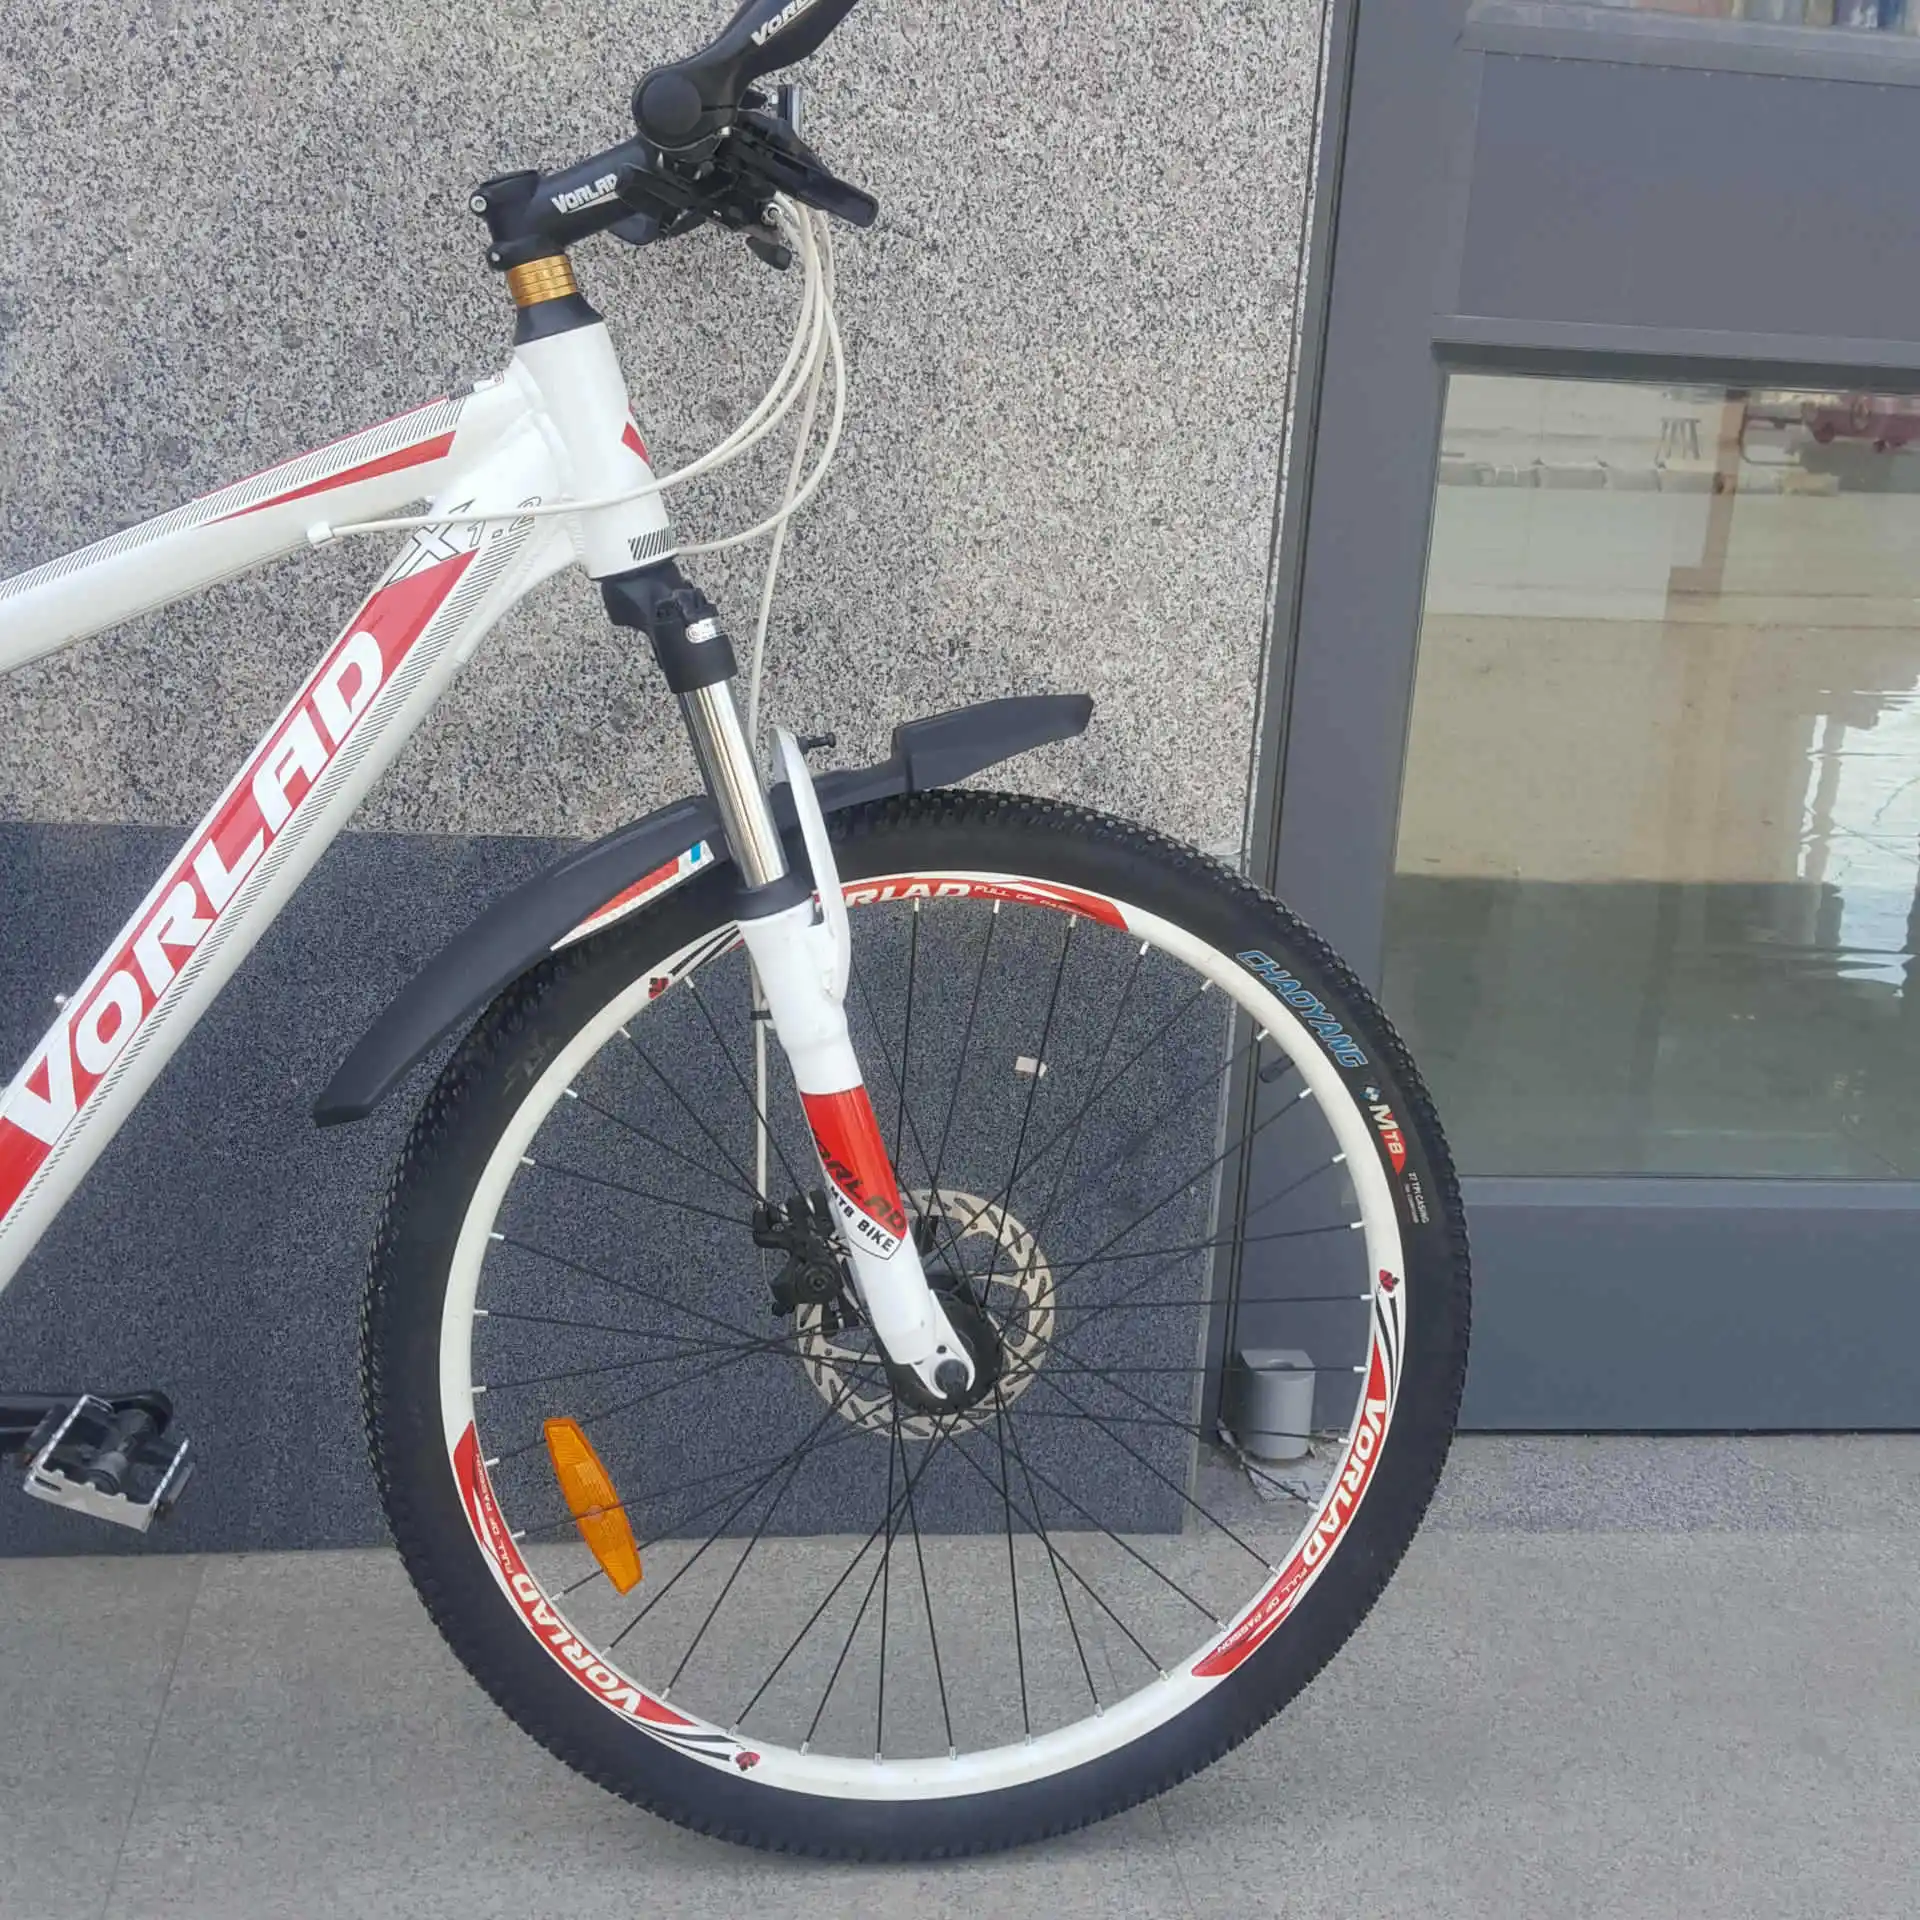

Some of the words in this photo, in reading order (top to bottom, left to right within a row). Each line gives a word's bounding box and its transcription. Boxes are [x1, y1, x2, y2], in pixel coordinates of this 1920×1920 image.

[2, 631, 385, 1146] VORLAD
[1236, 949, 1368, 1068] CHAOYANG
[1368, 1104, 1404, 1155] MTB
[856, 1218, 895, 1252] BIKE
[1302, 1399, 1387, 1567] VORLAD
[1281, 1567, 1308, 1593] FULL
[511, 1573, 644, 1714] VORLAD
